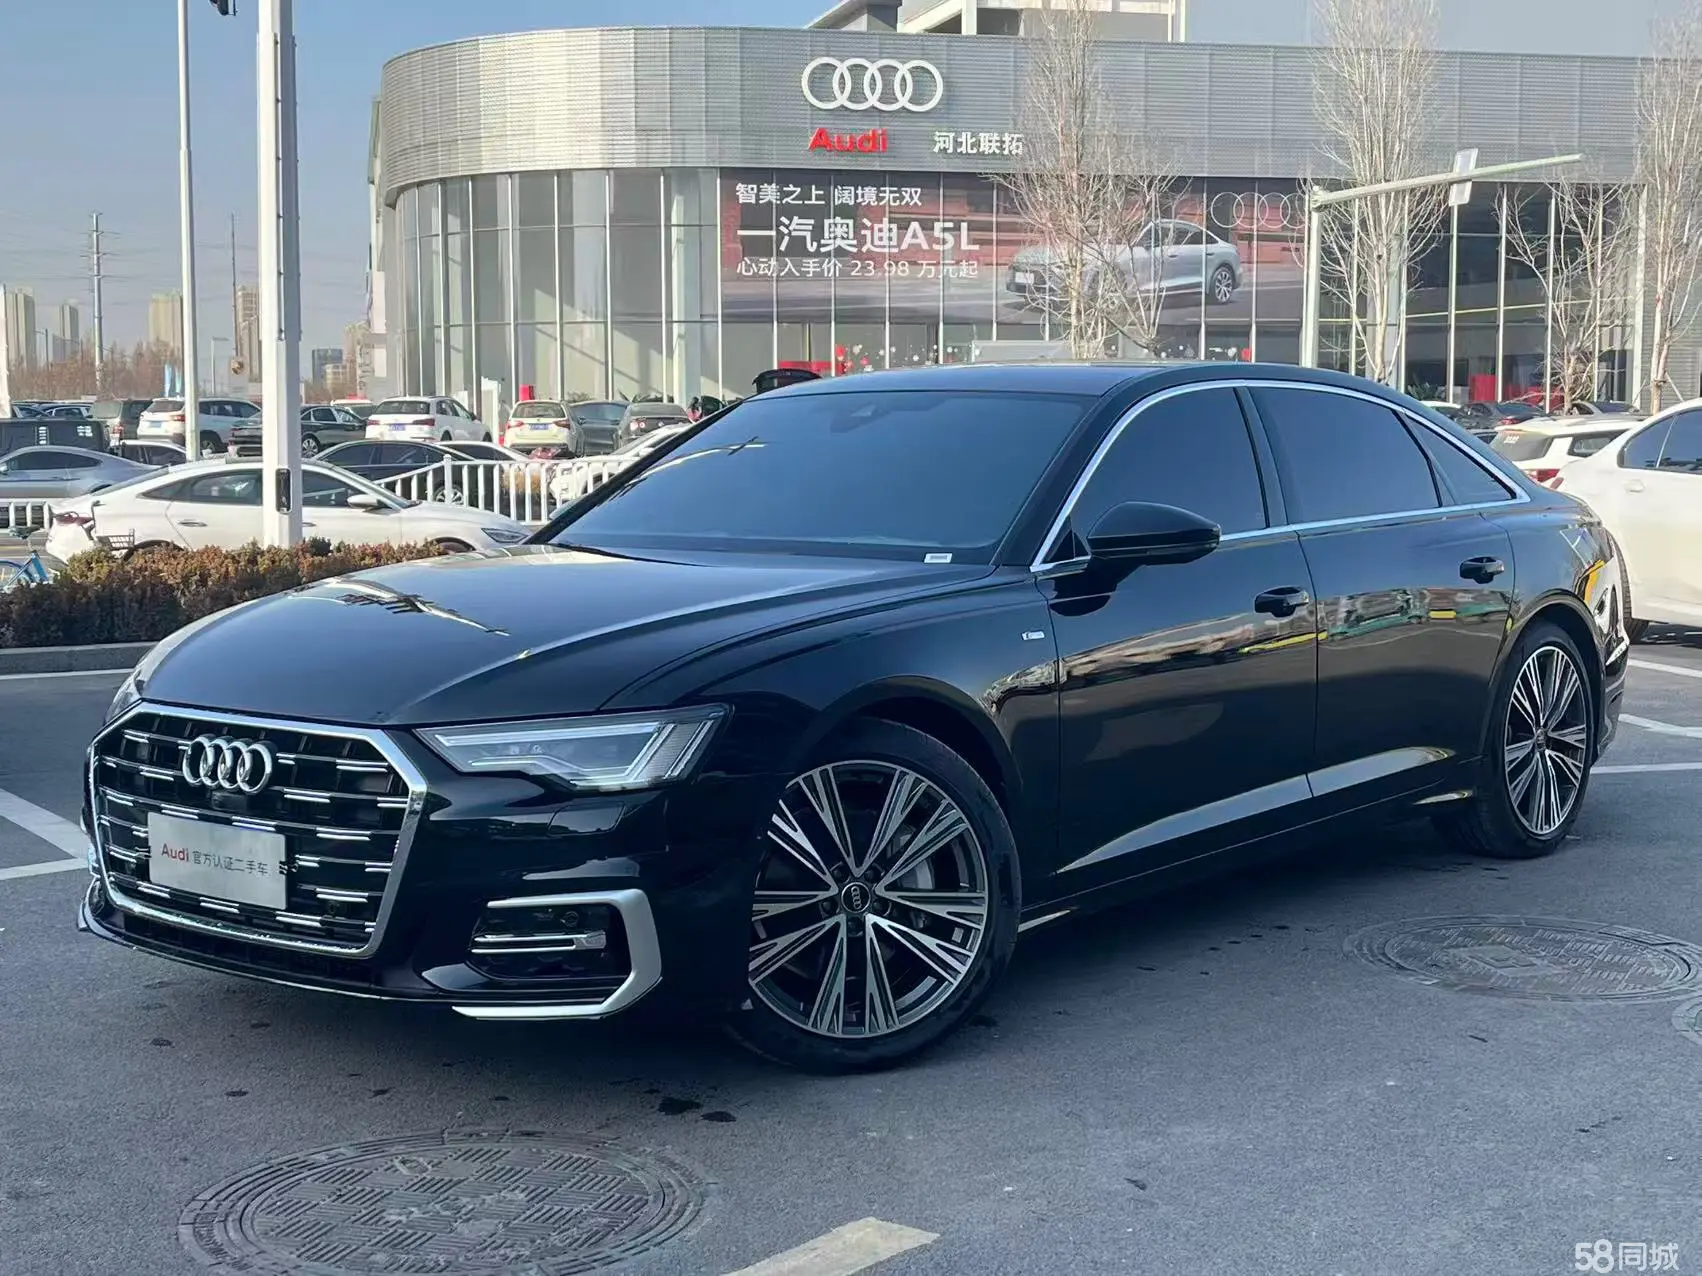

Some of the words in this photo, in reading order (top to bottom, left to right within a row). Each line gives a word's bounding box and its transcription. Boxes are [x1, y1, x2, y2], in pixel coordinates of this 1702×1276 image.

[808, 128, 888, 153] Audi
[933, 131, 1024, 155] 河北联拓
[736, 183, 825, 204] 智美之上
[835, 185, 922, 206] 阔境无双
[737, 216, 980, 253] 一汽奥迪A5L
[737, 257, 842, 278] 心动入手价
[851, 260, 909, 277] 23.98
[917, 260, 978, 278] 万元起
[161, 843, 189, 862] Audi
[192, 851, 269, 876] 官方认证二手车
